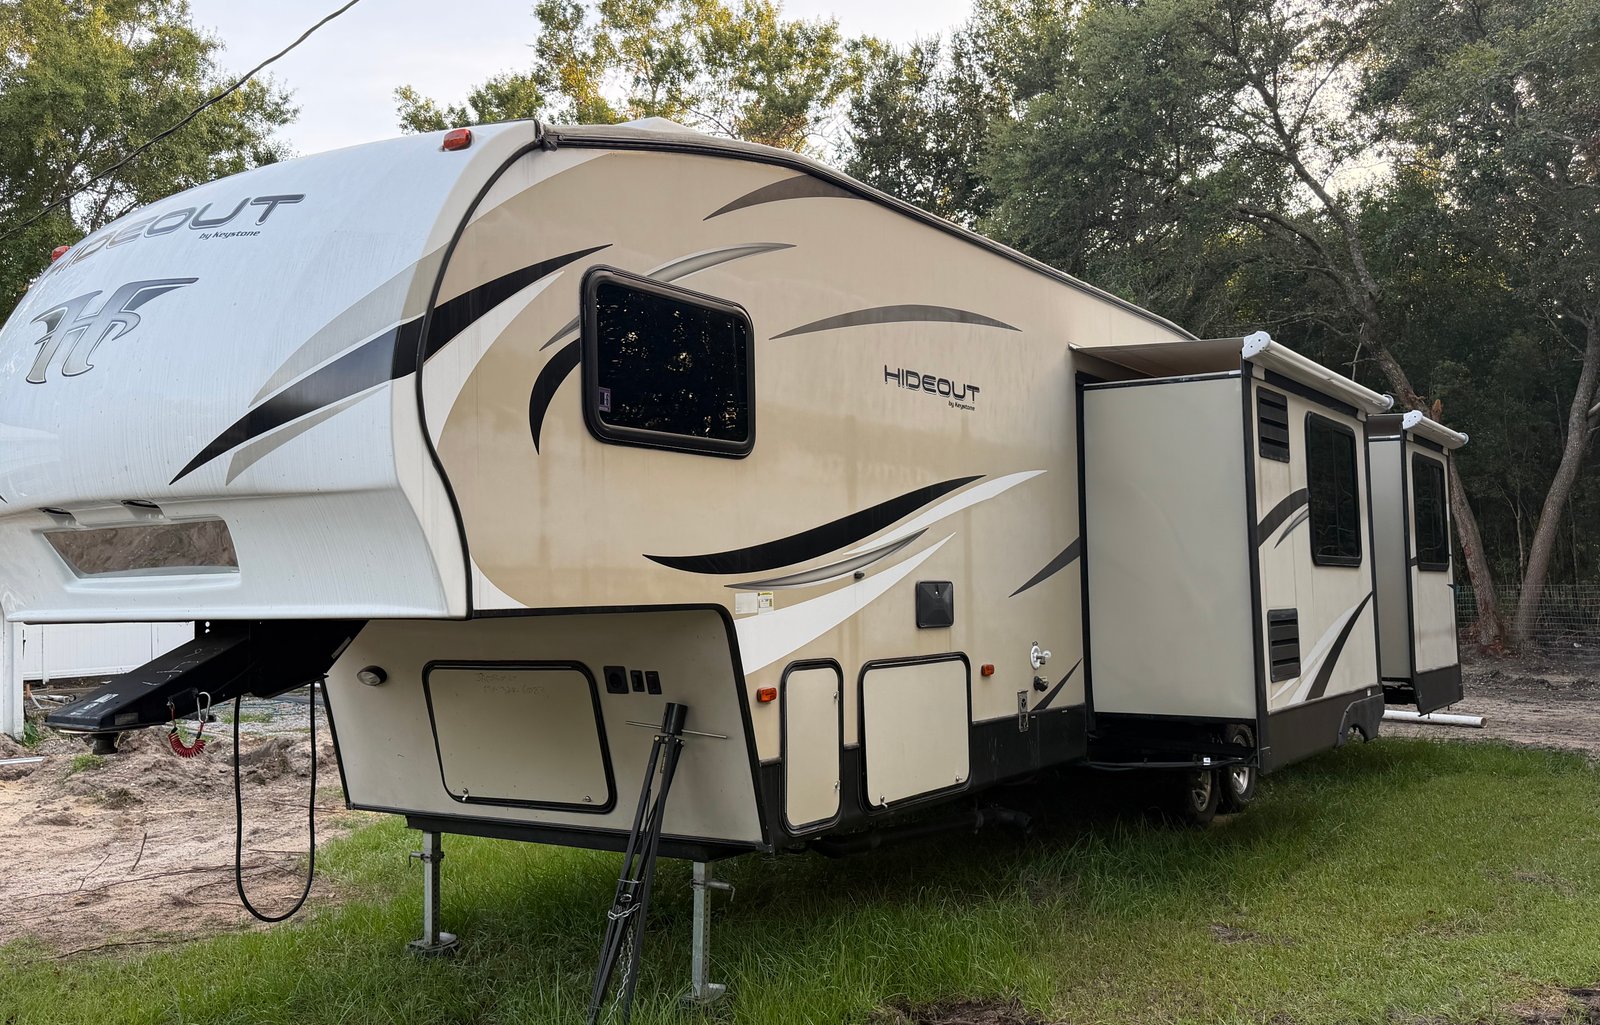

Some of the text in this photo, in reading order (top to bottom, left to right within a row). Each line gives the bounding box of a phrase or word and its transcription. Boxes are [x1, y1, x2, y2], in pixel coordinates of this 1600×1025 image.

[199, 231, 261, 240] by Keystone
[884, 364, 980, 404] HIDEOUT
